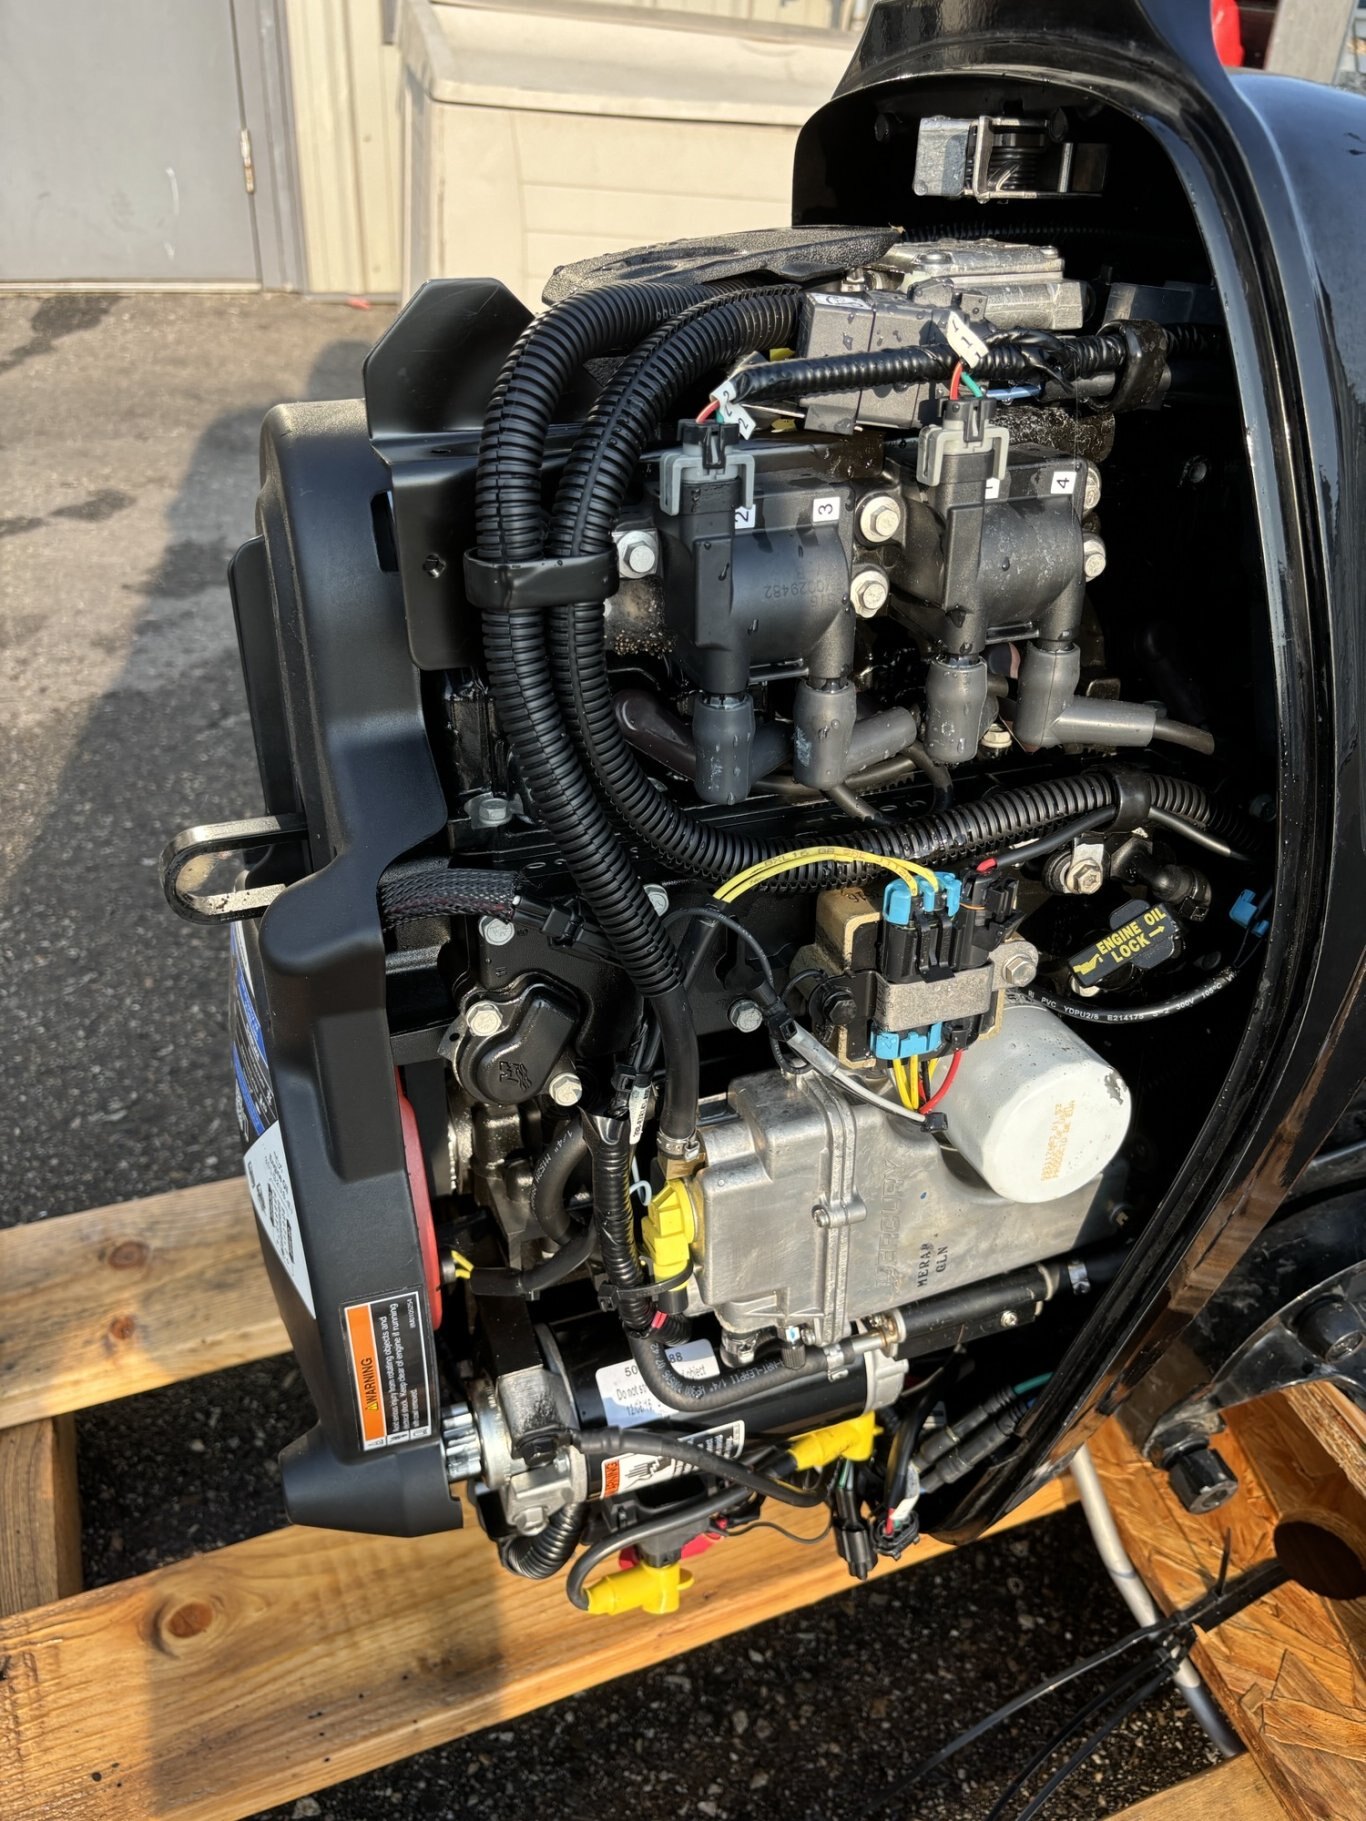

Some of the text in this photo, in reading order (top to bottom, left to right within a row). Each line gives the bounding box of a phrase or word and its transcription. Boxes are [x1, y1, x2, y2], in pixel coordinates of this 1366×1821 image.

[1056, 477, 1070, 489] 4
[735, 510, 749, 522] 2
[818, 503, 834, 516] 3
[1096, 907, 1167, 955] ENGINE OIL
[1111, 932, 1151, 963] LOCK
[1041, 996, 1057, 1008] PVC
[935, 1246, 948, 1273] GLN
[389, 1303, 400, 1330] running
[381, 1330, 392, 1355] objects
[394, 1336, 404, 1359] engine
[385, 1355, 395, 1378] rotating
[361, 1357, 376, 1404] WARNING
